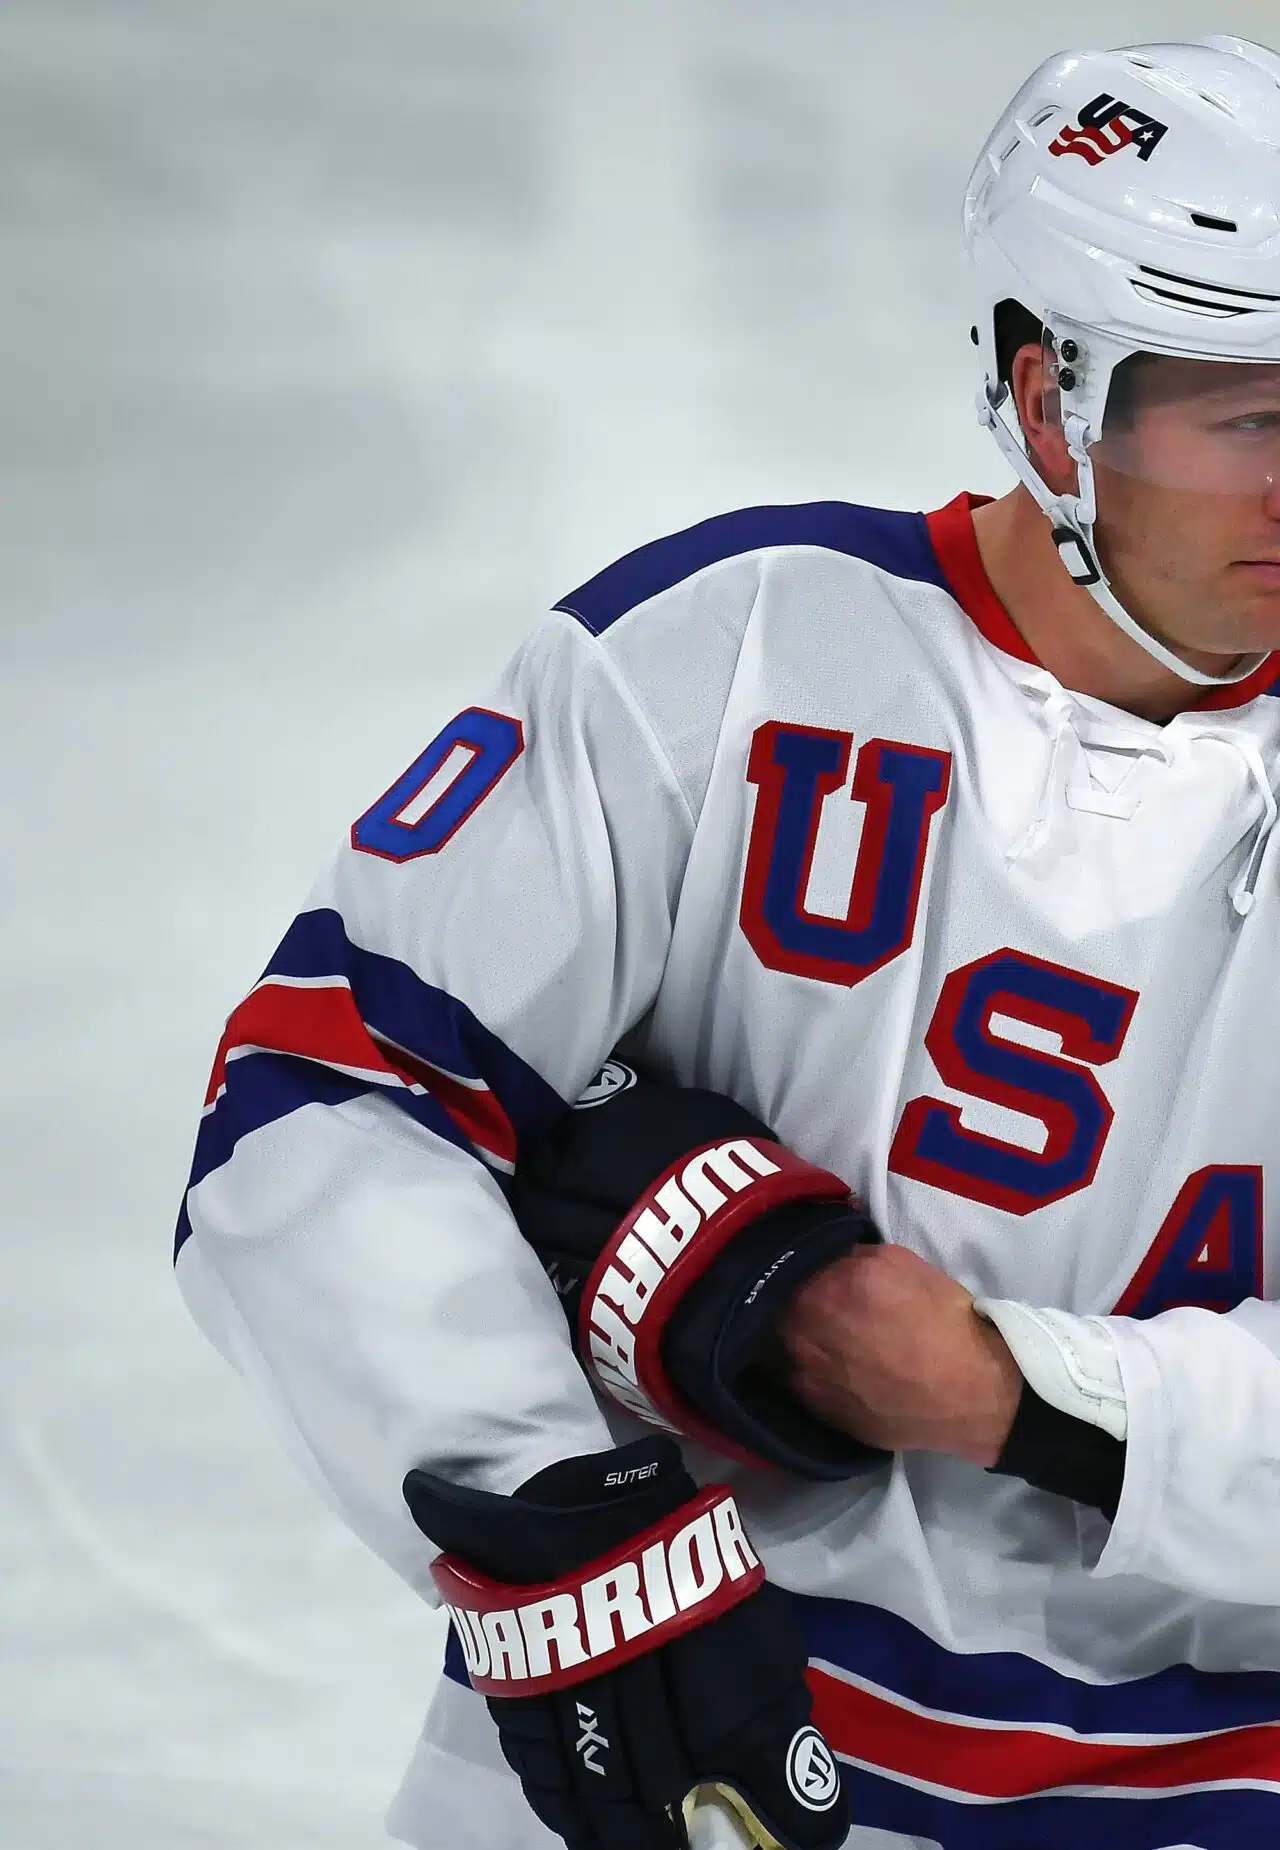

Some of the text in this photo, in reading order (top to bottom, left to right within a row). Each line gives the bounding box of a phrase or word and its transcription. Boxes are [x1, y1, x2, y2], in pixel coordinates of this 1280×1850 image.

[1047, 92, 1169, 166] USA
[603, 1462, 659, 1487] SUTER
[444, 1496, 760, 1681] WARRIOR
